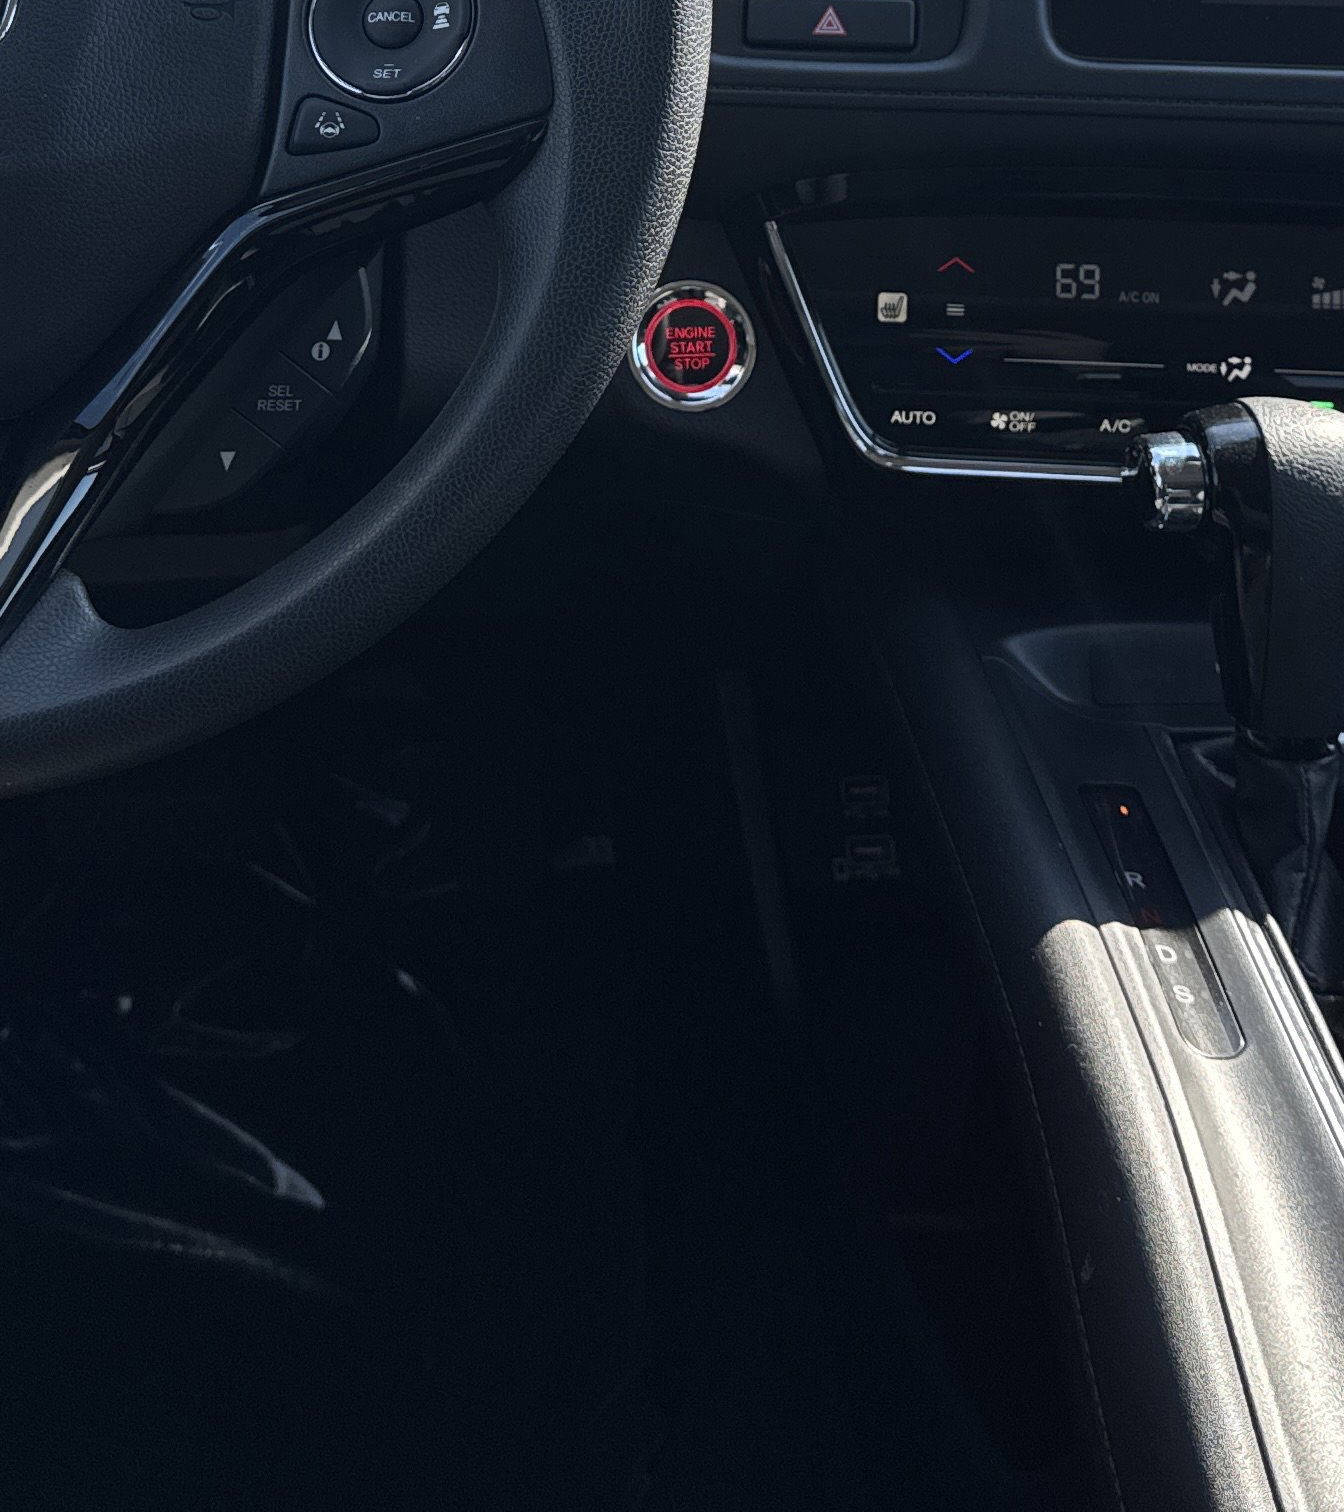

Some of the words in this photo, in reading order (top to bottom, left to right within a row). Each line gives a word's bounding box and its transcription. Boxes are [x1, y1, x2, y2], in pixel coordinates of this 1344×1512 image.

[367, 10, 416, 24] CANCEL
[372, 67, 402, 79] SET
[1056, 263, 1101, 300] 69
[1118, 291, 1140, 304] A/C
[1142, 291, 1160, 304] ON
[665, 326, 716, 339] ENGINE
[669, 340, 713, 354] START
[674, 357, 710, 369] STOP
[1186, 362, 1218, 374] MODE
[267, 385, 294, 397] SEL
[256, 399, 303, 411] RESET
[891, 410, 937, 426] AUTO
[1008, 410, 1036, 422] ON/
[1009, 422, 1037, 433] OFF
[1099, 418, 1132, 433] A/C
[1125, 871, 1145, 888] R
[1156, 944, 1177, 962] D
[1173, 985, 1194, 1003] S
